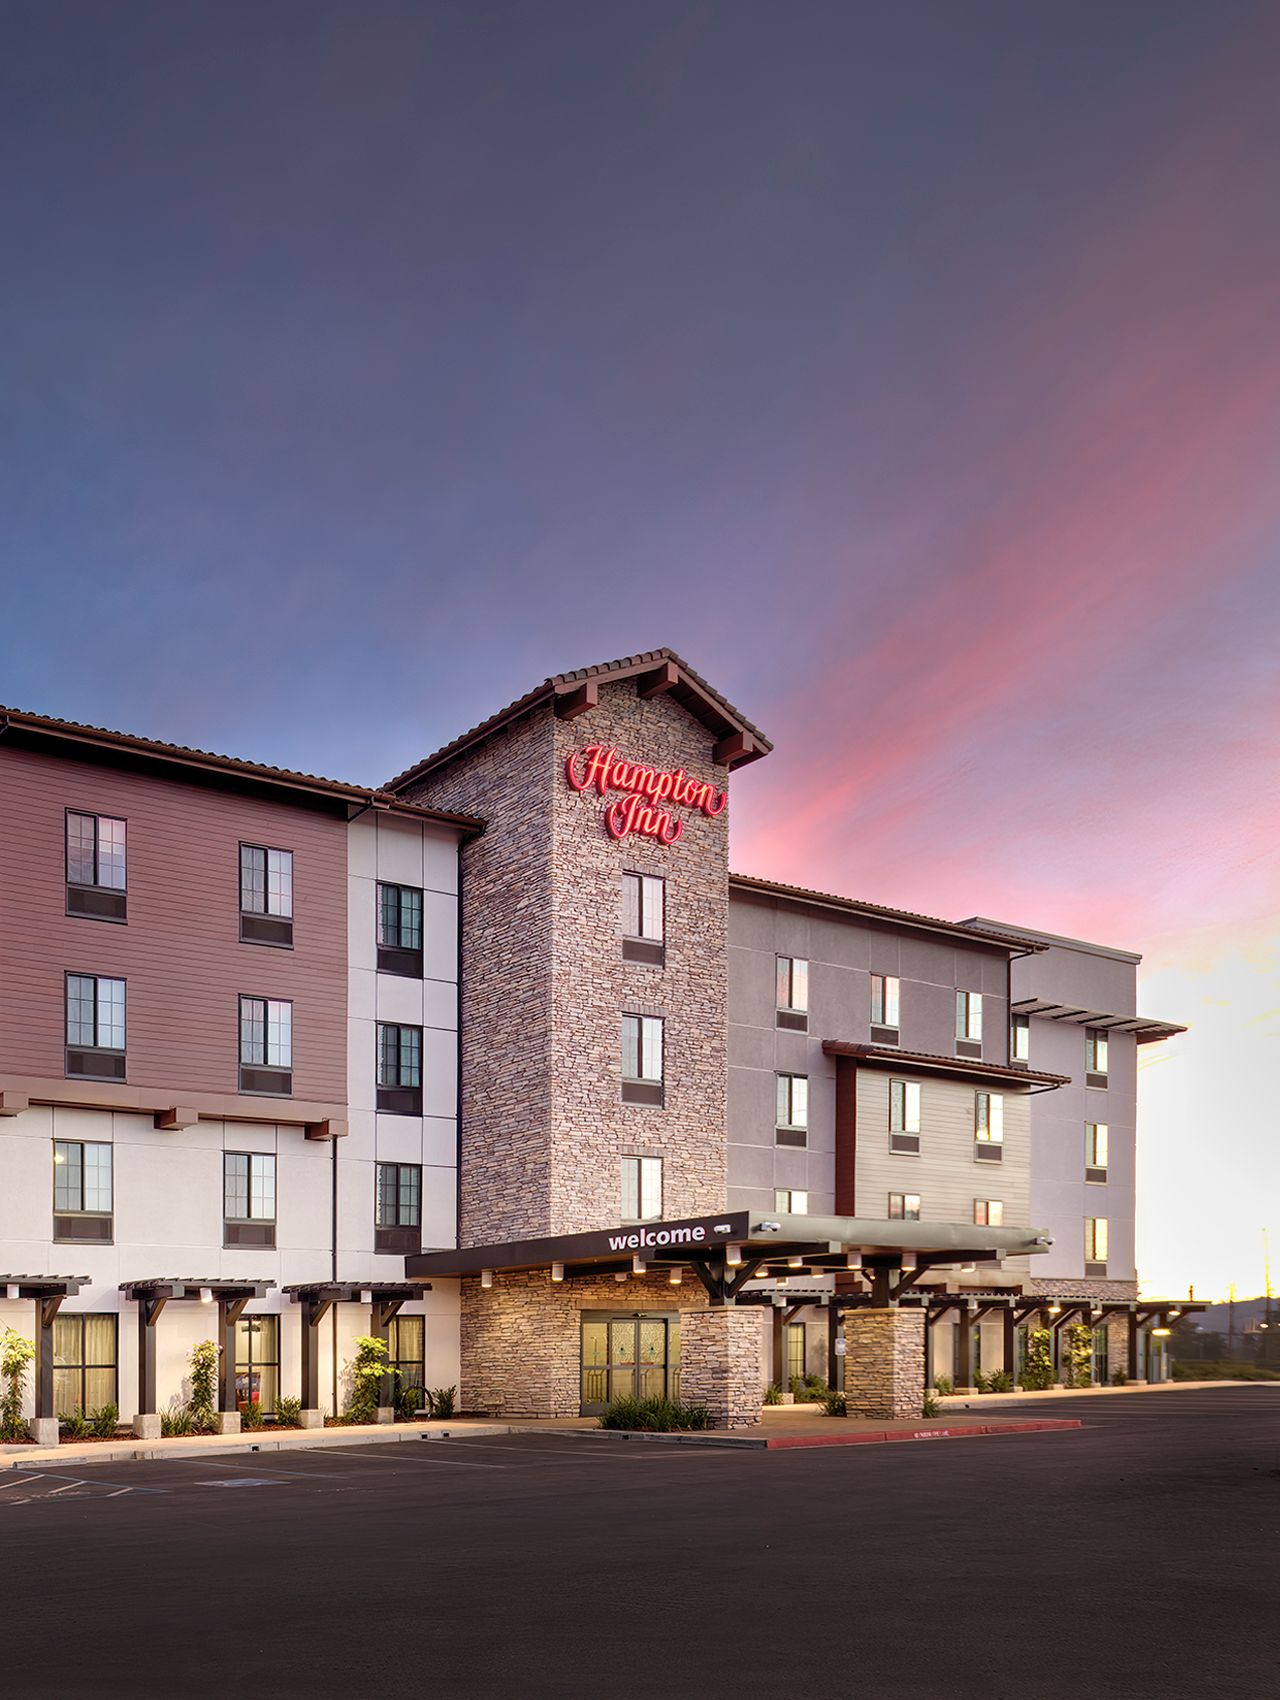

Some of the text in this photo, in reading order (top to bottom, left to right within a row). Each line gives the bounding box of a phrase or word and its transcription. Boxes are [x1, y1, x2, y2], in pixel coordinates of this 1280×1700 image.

[566, 745, 727, 816] Hampton
[606, 792, 683, 844] Inn
[609, 1226, 706, 1250] welcome
